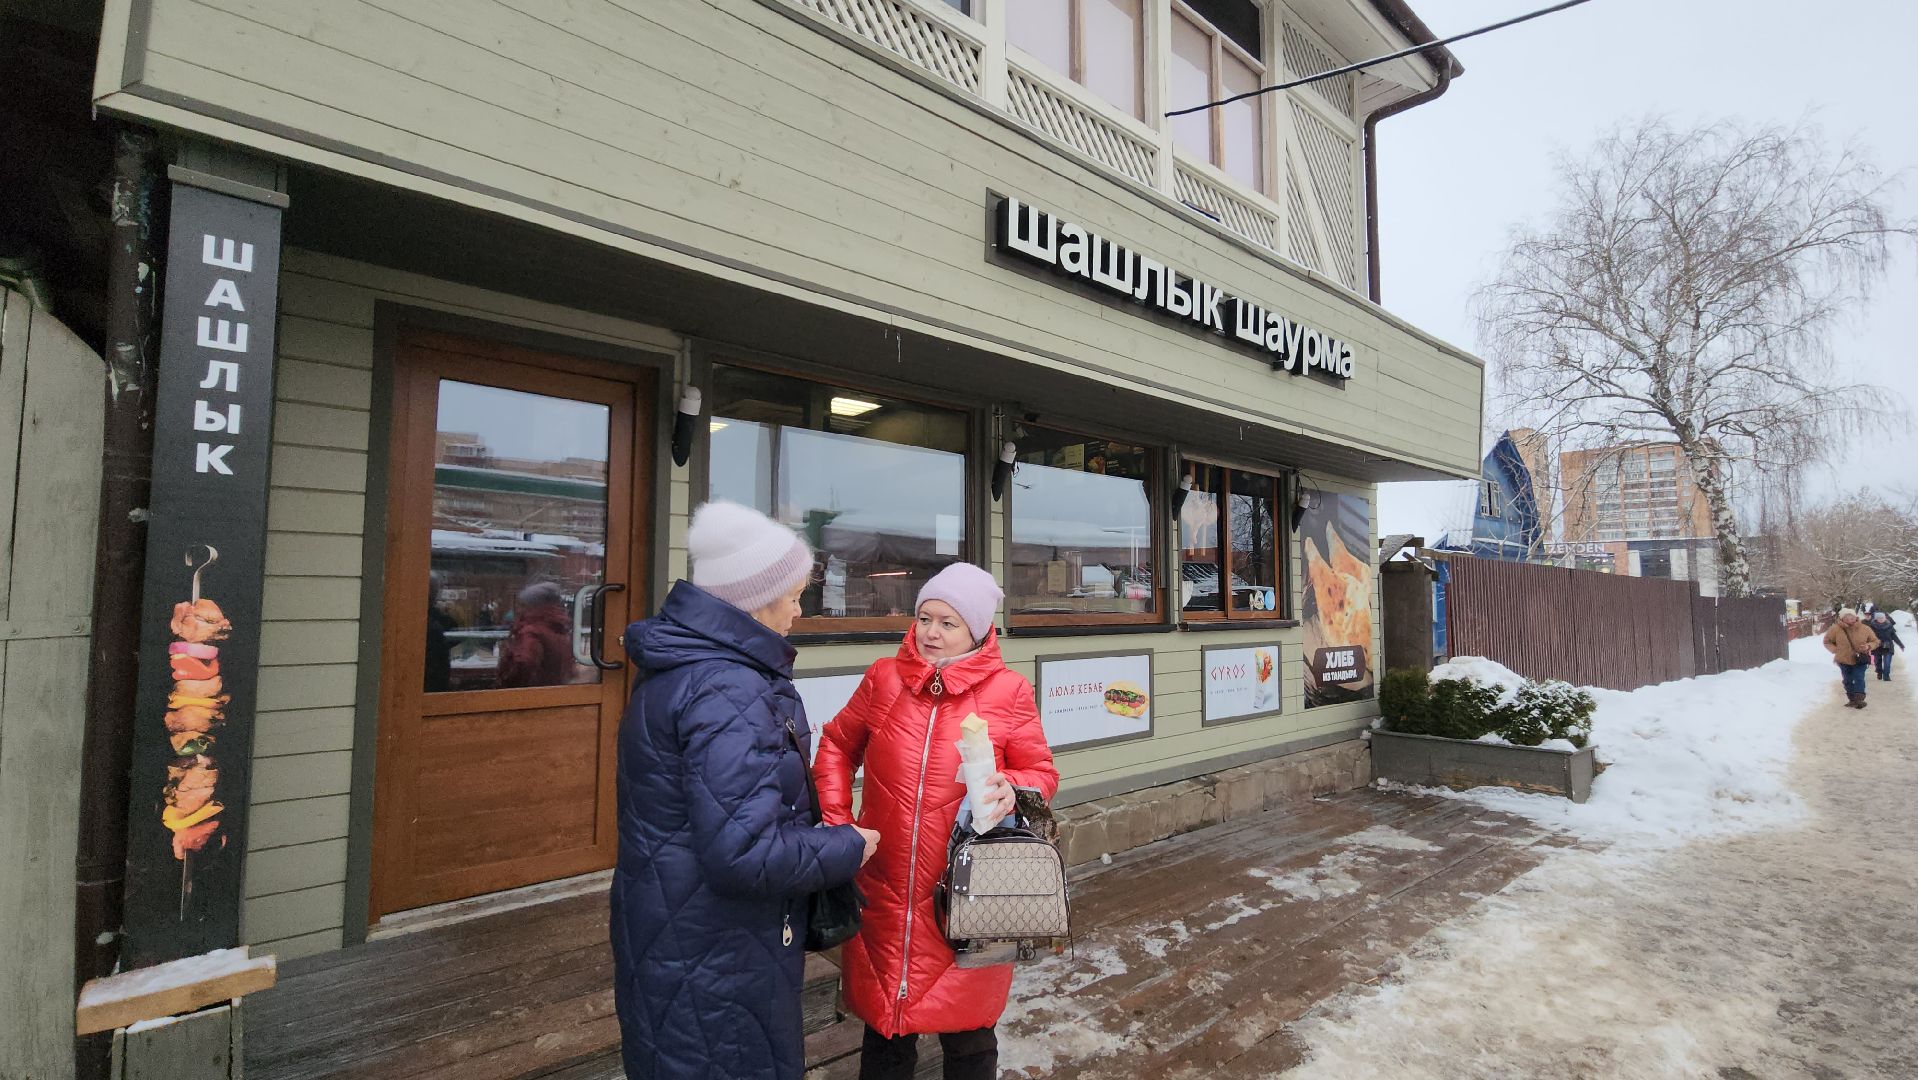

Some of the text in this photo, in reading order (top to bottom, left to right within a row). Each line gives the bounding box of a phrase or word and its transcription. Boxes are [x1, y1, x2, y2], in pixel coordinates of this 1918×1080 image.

[1236, 296, 1357, 377] шаурма
[193, 233, 254, 475] ШАШЛЫК
[1325, 650, 1355, 669] ХЛЕБ
[1211, 663, 1246, 681] GYROS
[1322, 669, 1358, 682] ИЗ ТАНДЫРА
[1049, 682, 1103, 698] ЛЮЛЯ КЕБАБ
